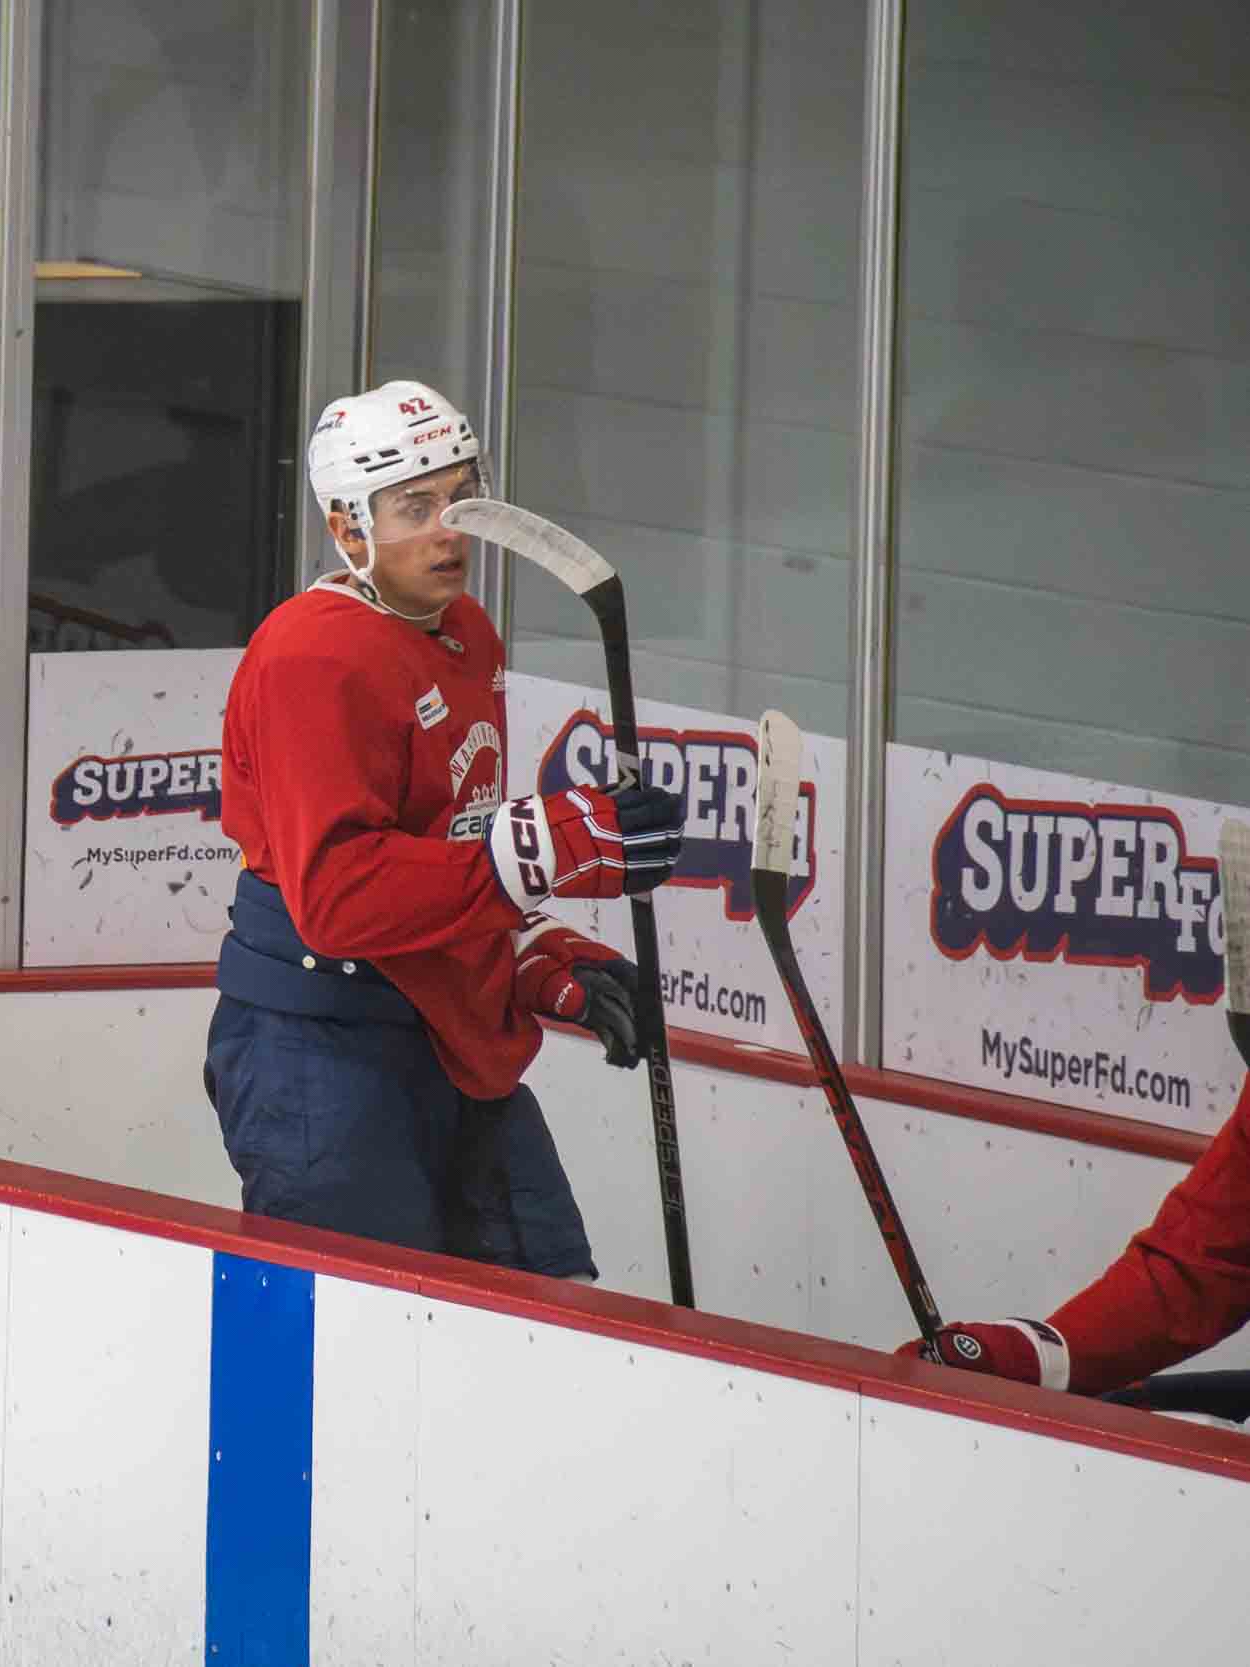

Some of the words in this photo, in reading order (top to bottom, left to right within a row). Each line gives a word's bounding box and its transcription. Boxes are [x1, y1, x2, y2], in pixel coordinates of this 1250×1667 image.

[413, 424, 452, 445] CCM
[565, 721, 759, 842] SPER
[960, 798, 1181, 920] SUPER
[981, 1027, 1191, 1108] MySuperFd.com
